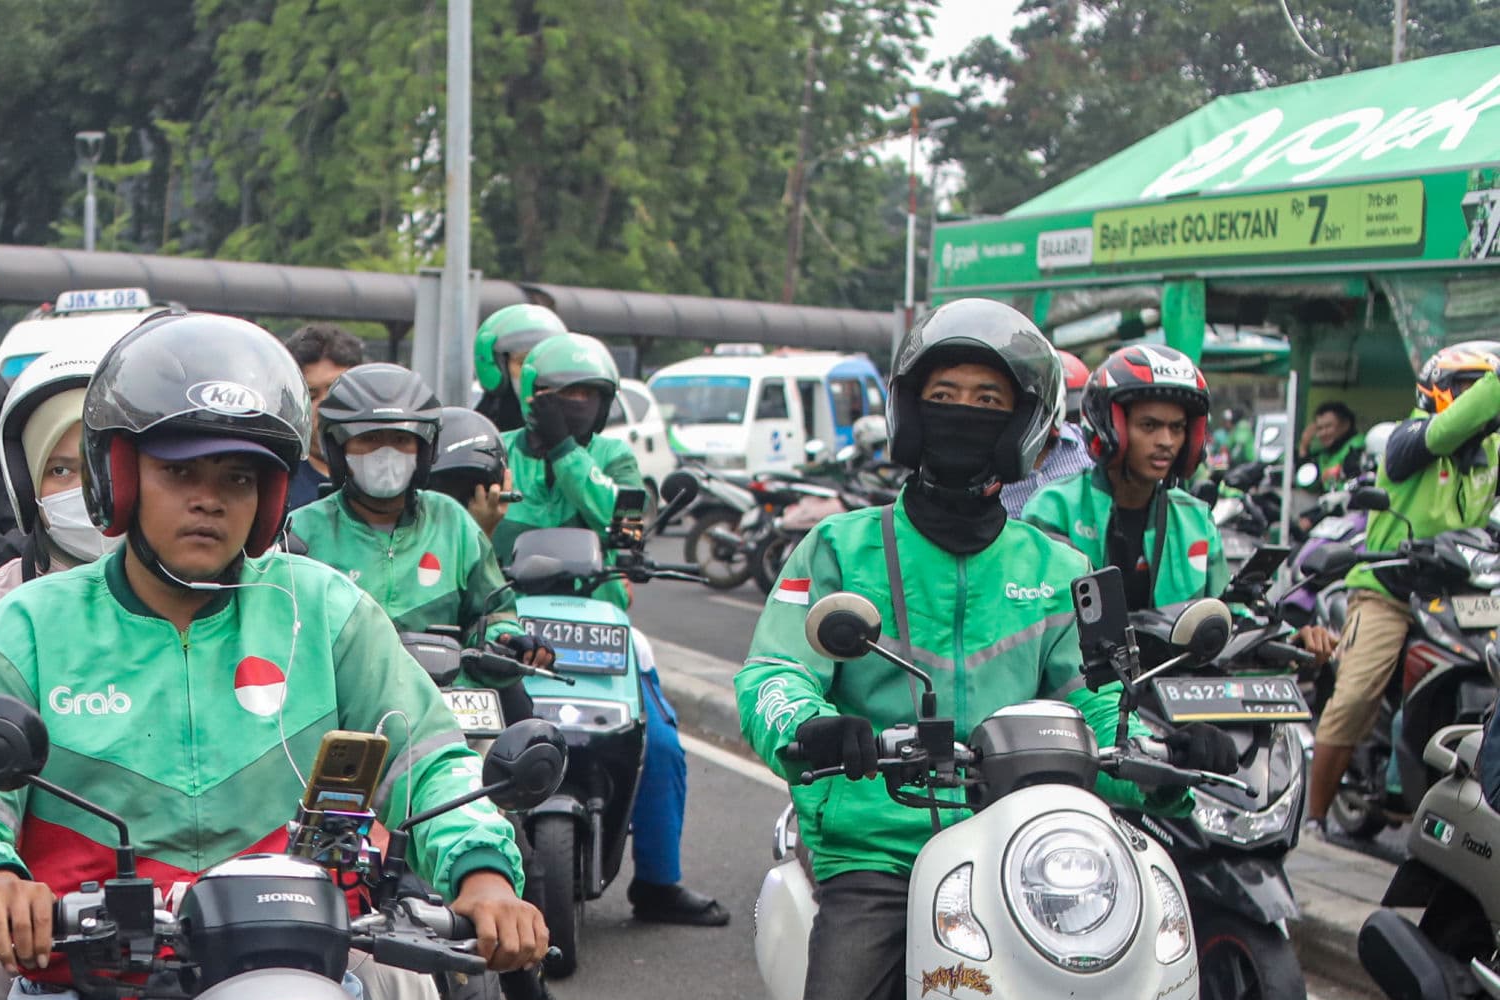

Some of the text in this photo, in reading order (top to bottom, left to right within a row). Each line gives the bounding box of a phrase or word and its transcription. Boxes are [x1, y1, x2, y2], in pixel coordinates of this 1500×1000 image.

[1100, 207, 1279, 256] Beli paket GOJEK7AN
[1291, 197, 1305, 220] Rp
[1308, 195, 1328, 245] 7
[1005, 581, 1056, 600] Grab
[542, 621, 583, 644] 4178
[589, 627, 623, 648] SWG
[48, 684, 132, 716] Grab
[452, 693, 490, 711] KKV
[1165, 685, 1181, 701] B
[1038, 728, 1078, 740] HONDA
[1141, 813, 1174, 847] HONDA
[256, 893, 317, 906] HONDA
